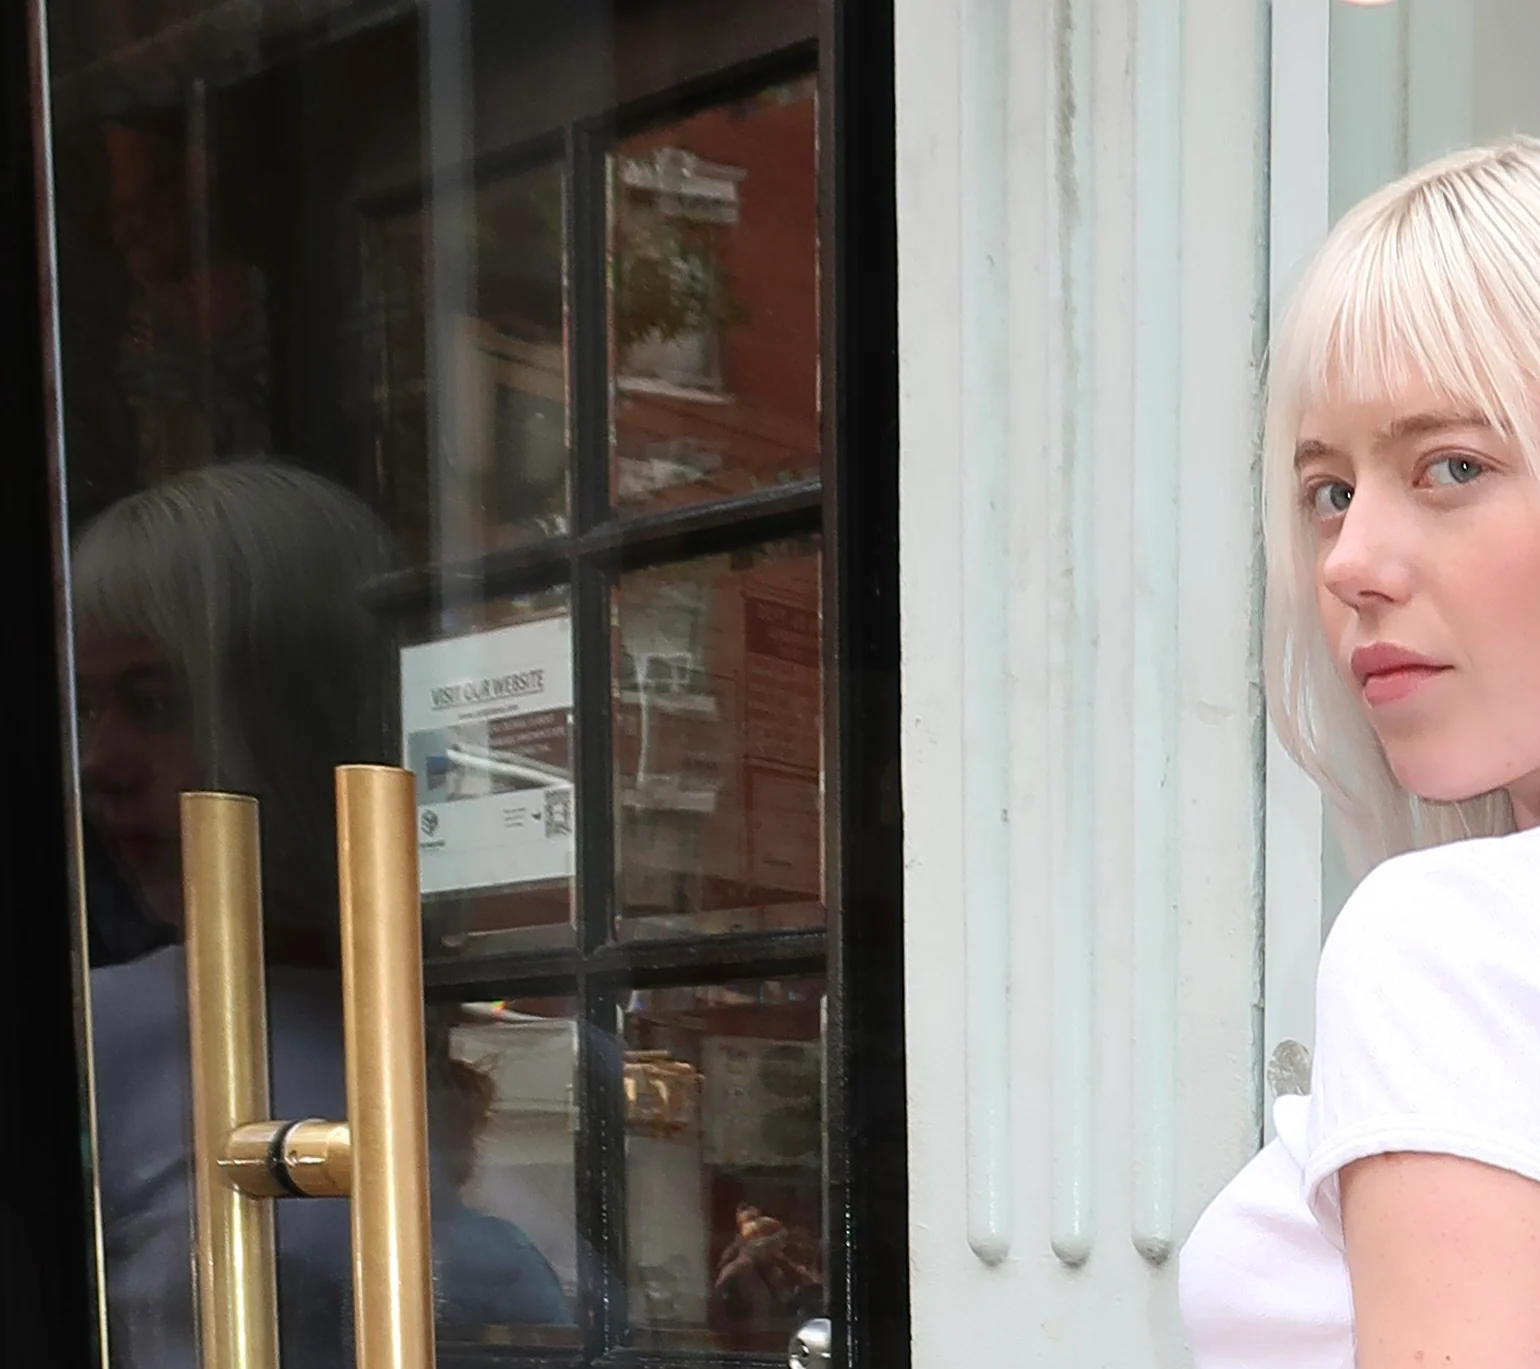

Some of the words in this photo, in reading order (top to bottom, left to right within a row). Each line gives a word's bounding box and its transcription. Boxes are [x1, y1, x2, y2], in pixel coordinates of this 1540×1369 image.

[430, 684, 462, 706] VISIT
[464, 679, 490, 702] OUR
[490, 669, 544, 698] WEBSITE
